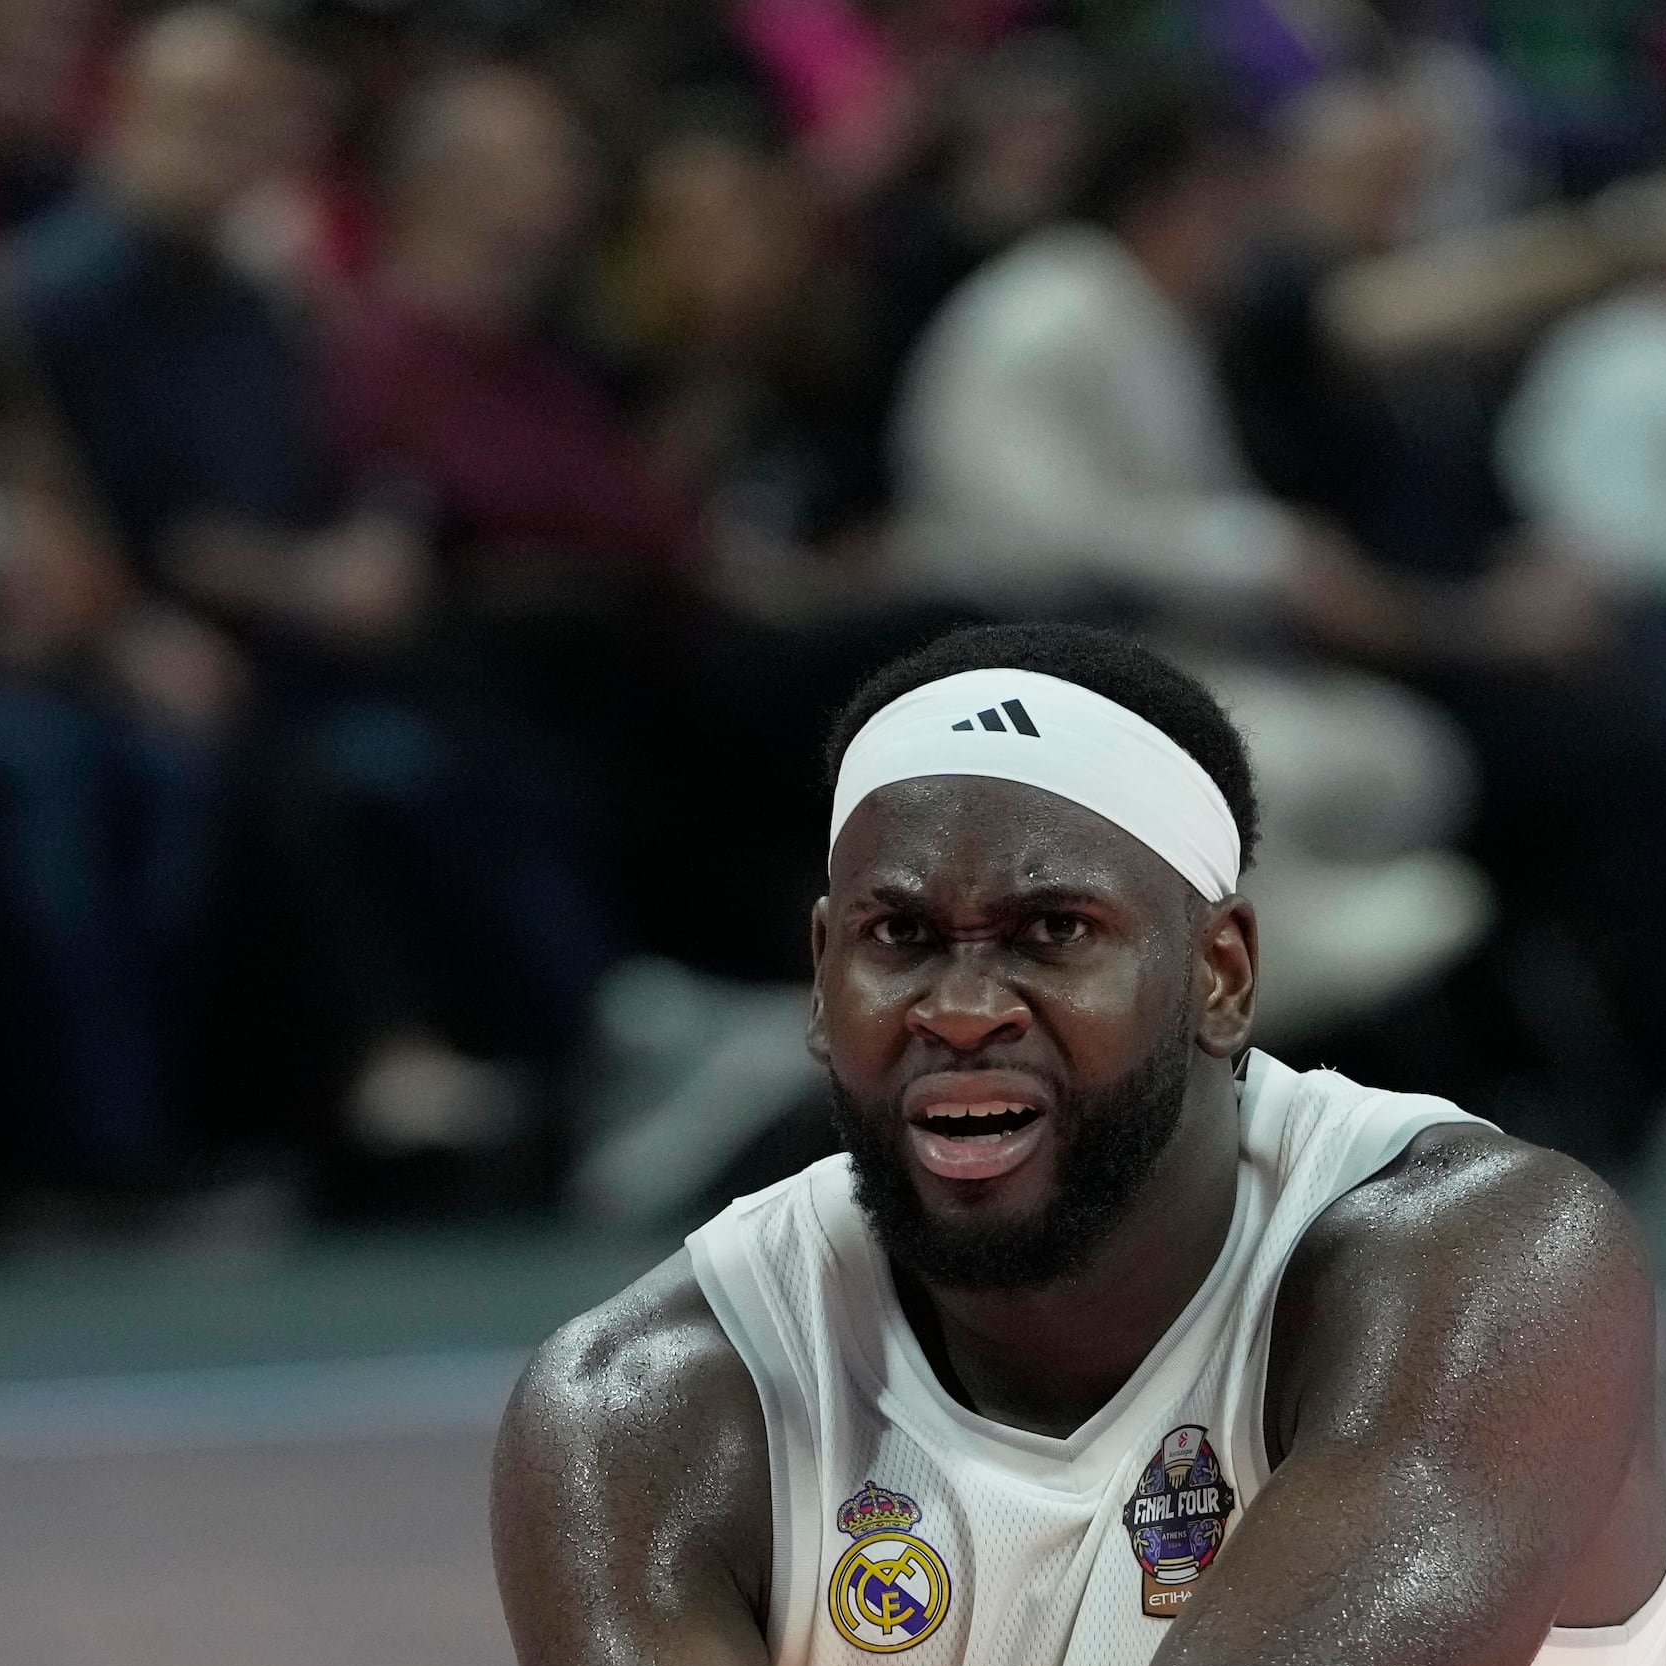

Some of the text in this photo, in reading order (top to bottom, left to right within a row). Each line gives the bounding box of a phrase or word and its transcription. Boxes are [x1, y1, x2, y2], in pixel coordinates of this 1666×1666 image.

[1134, 1487, 1221, 1526] FINAL FOUR
[1161, 1530, 1188, 1541] ATHENS
[1148, 1590, 1193, 1606] ETIHA
